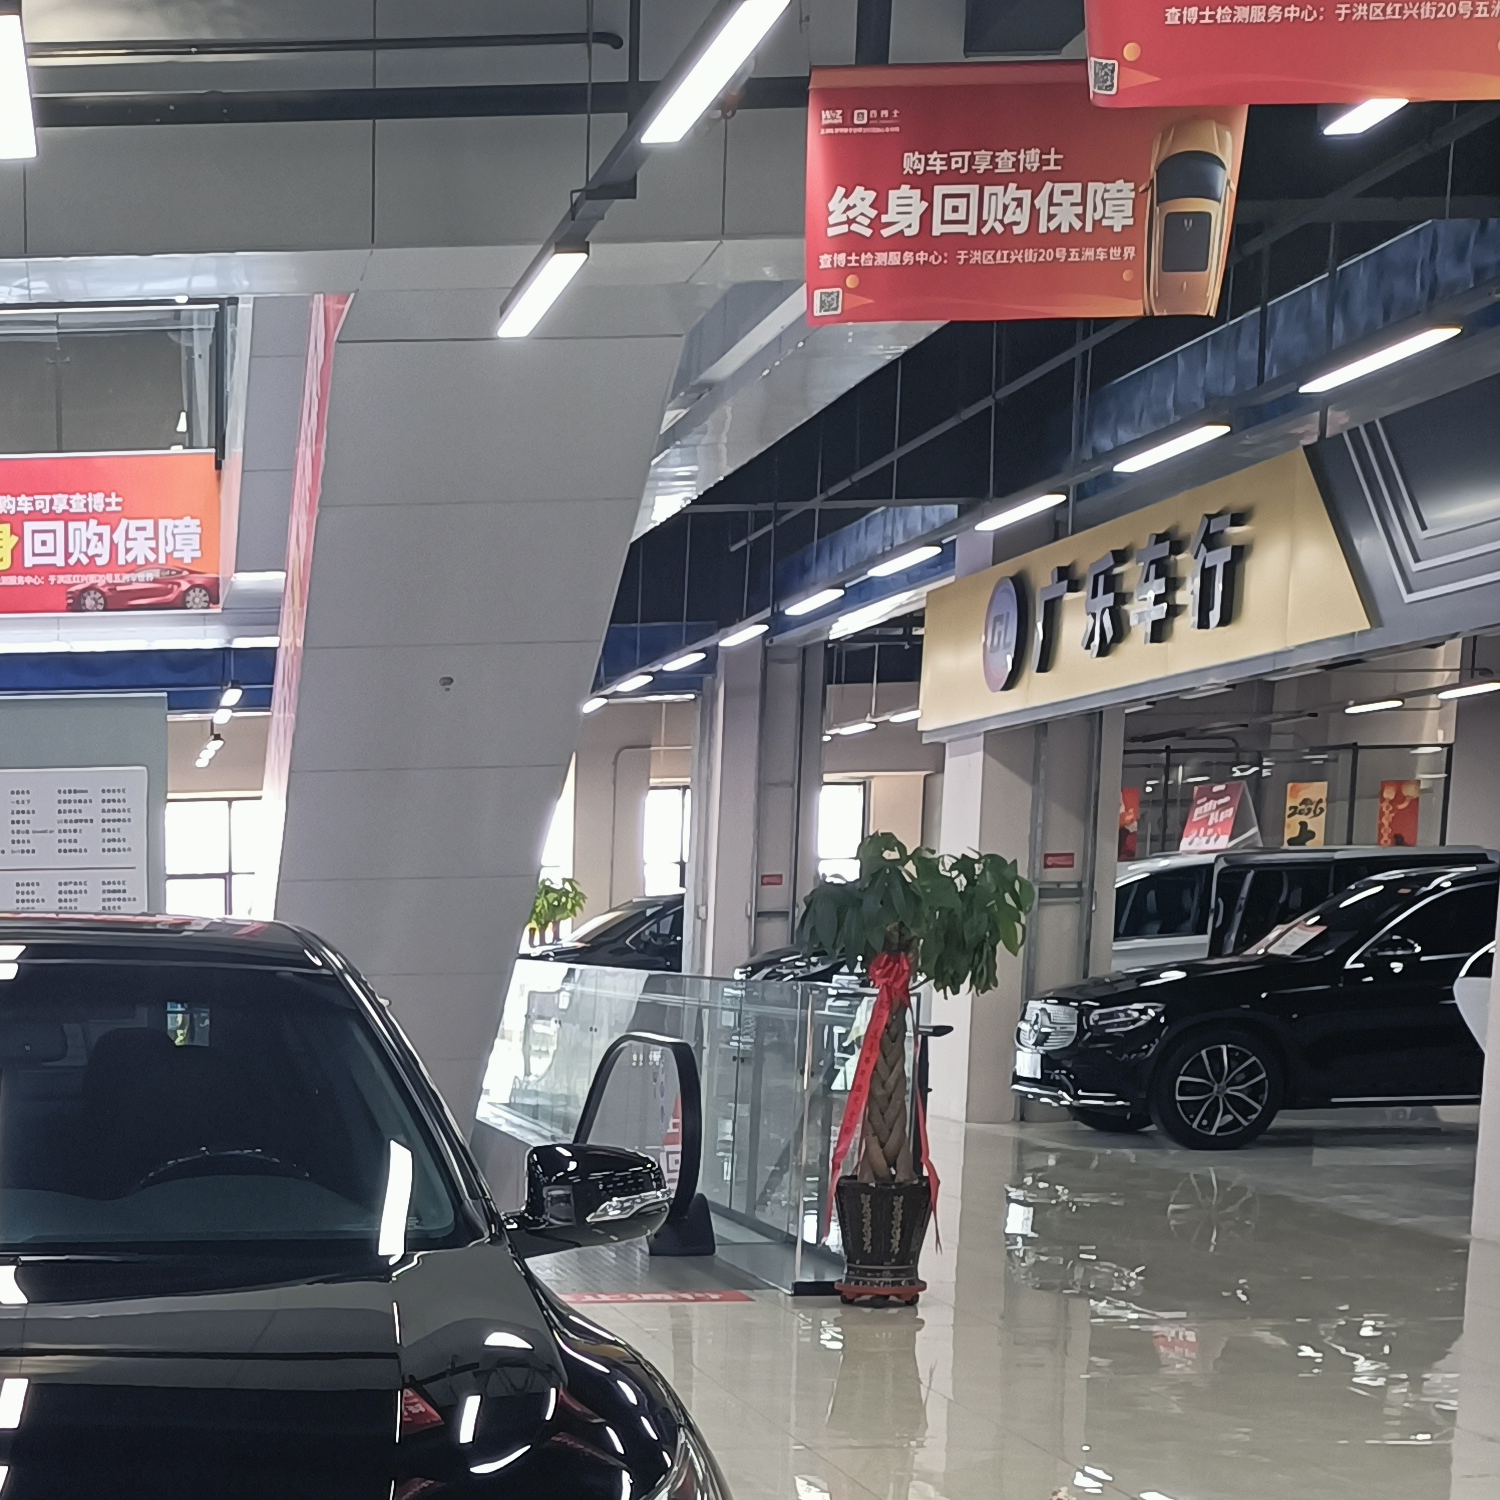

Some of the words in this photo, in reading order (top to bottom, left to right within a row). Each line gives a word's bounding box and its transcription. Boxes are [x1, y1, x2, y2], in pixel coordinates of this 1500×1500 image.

[902, 147, 1064, 175] 购车可享查博士
[826, 178, 1136, 238] 终身回购保障
